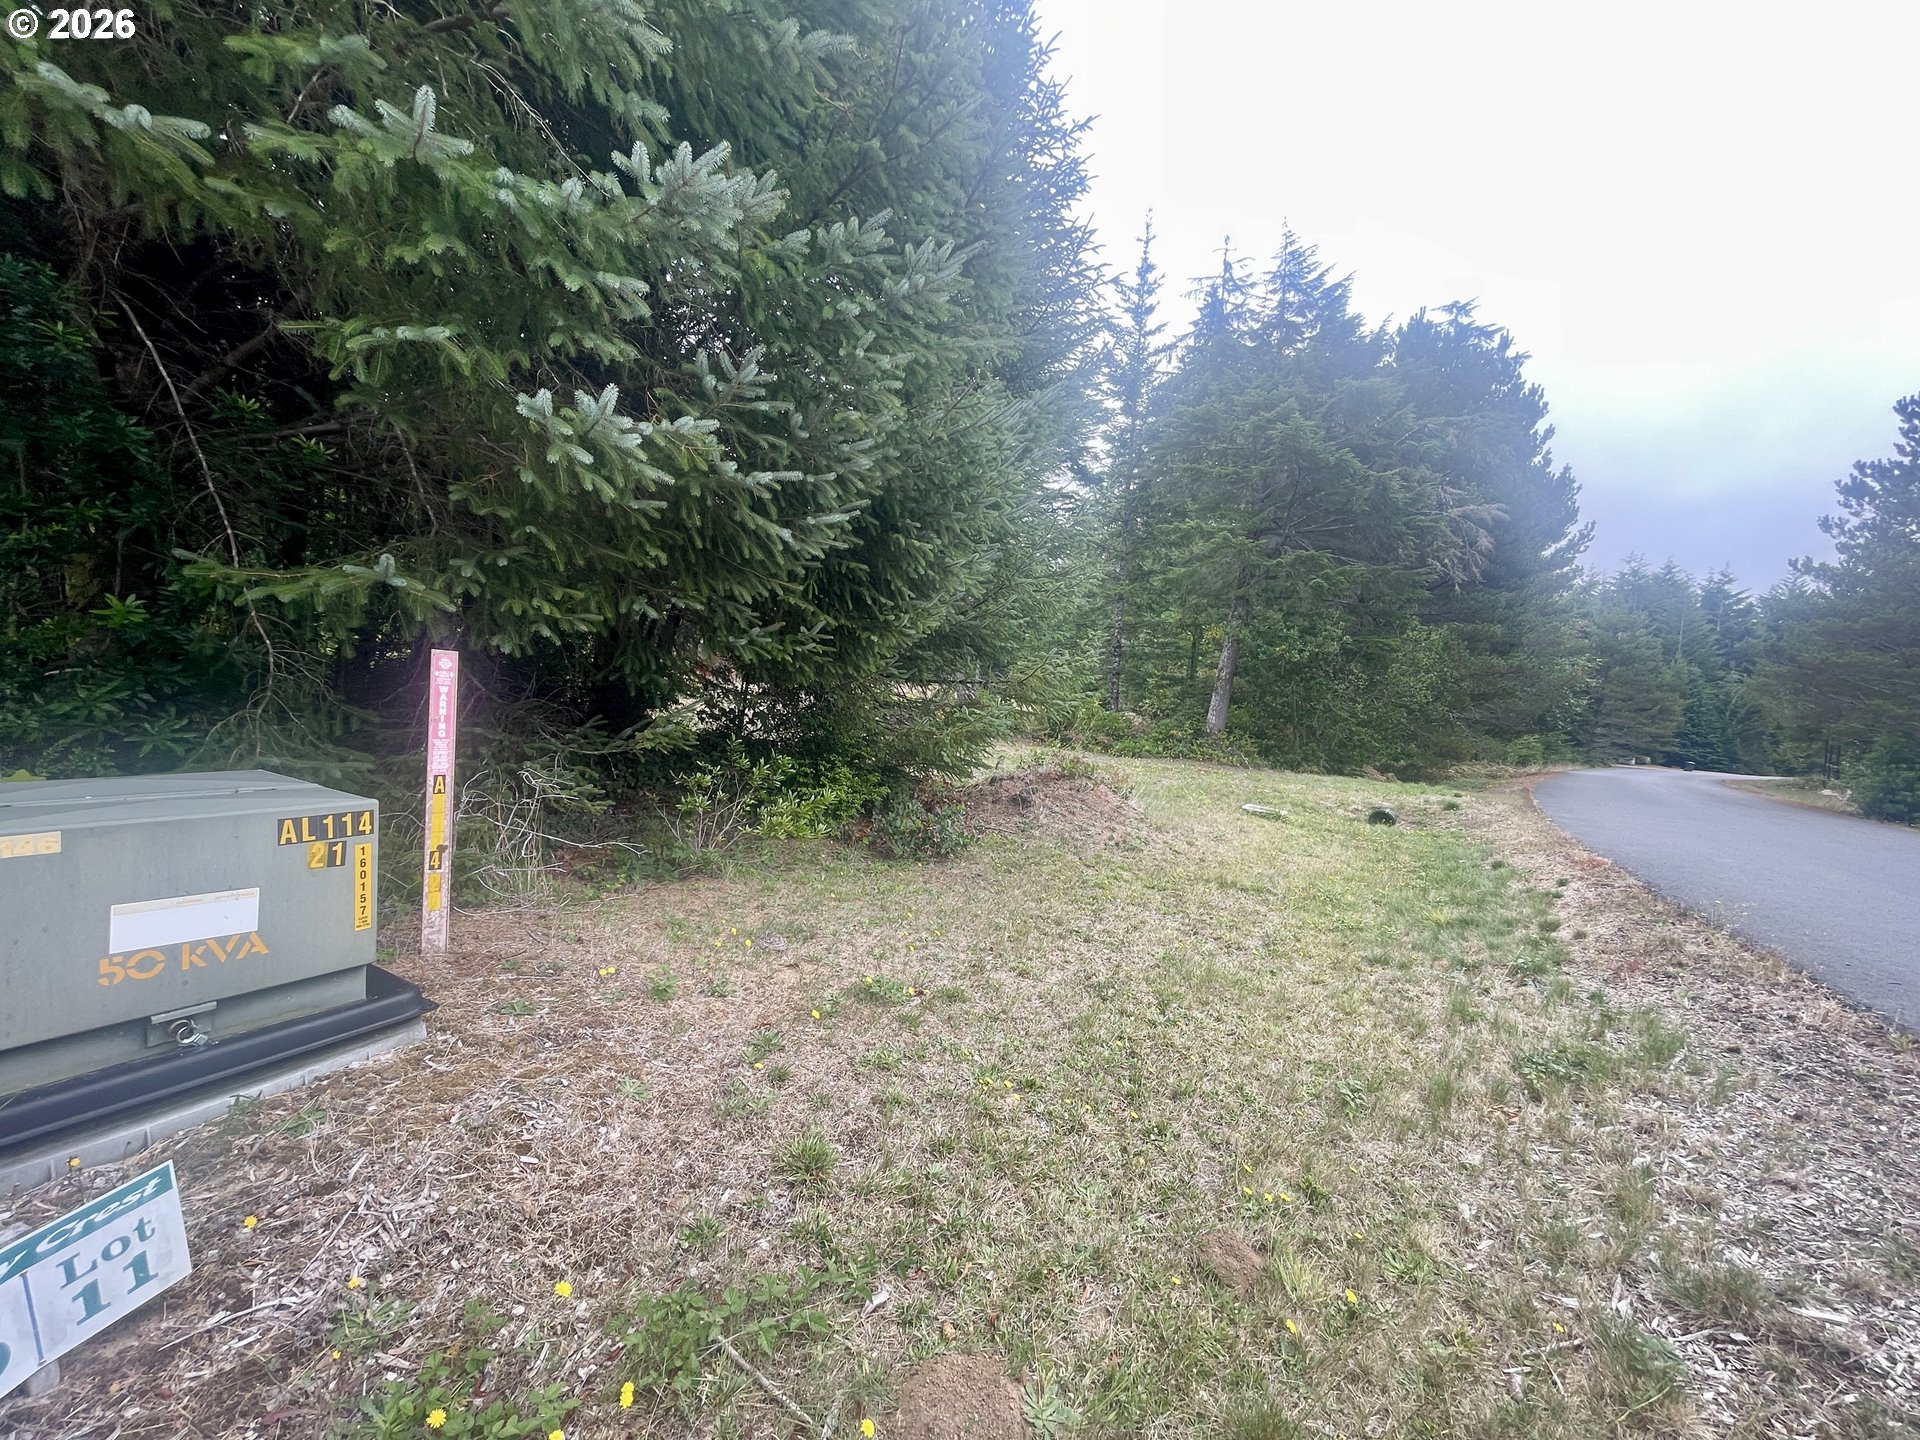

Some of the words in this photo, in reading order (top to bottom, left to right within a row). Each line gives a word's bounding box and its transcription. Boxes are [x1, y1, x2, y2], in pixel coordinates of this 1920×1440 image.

[437, 685, 449, 738] WARNING
[280, 811, 372, 845] AL114
[309, 842, 343, 869] 21
[359, 846, 367, 916] 160157
[97, 950, 165, 987] 50
[181, 932, 270, 971] KVA
[35, 1176, 163, 1254] Crest
[56, 1216, 156, 1290] Lot
[72, 1250, 159, 1326] 11
